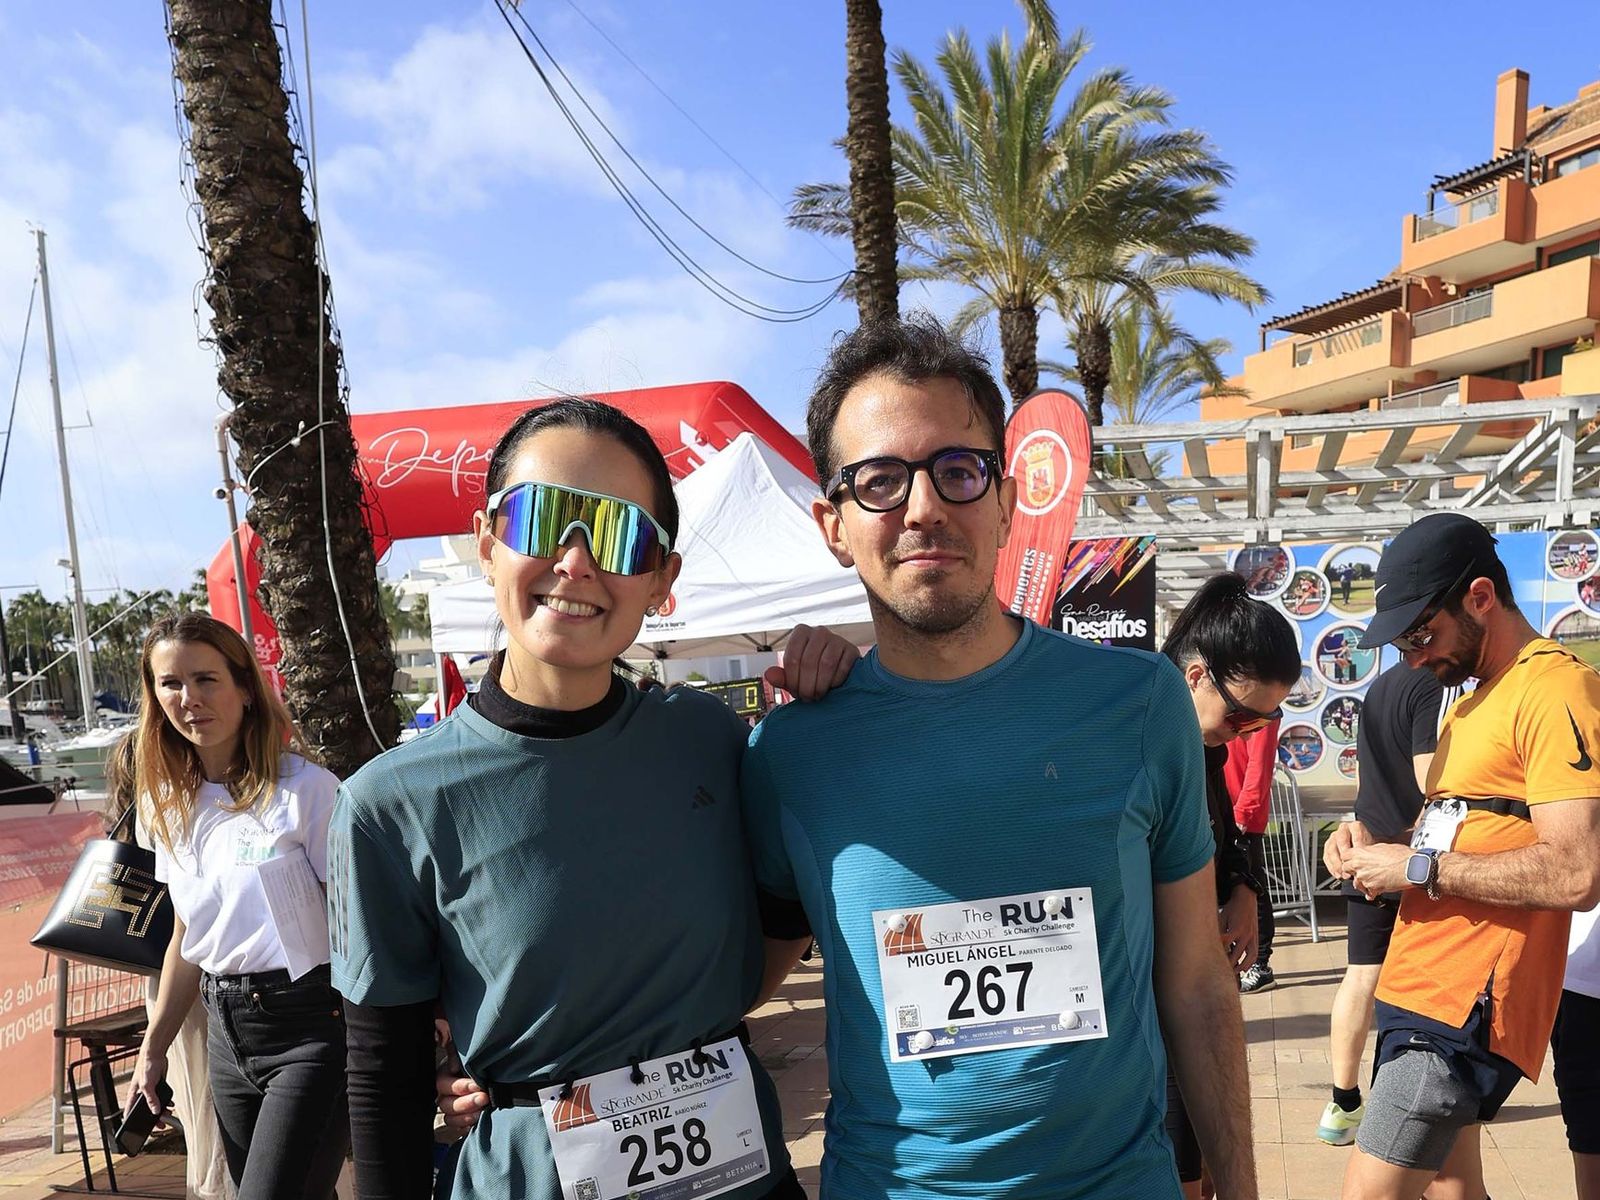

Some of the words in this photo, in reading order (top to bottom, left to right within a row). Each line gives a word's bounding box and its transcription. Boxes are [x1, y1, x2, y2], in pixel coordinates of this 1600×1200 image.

[369, 427, 494, 497] Depo
[1062, 613, 1147, 640] Desafíos
[962, 908, 993, 925] The
[1000, 896, 1074, 927] RUN
[1003, 928, 1012, 937] 5k
[1013, 925, 1040, 936] Charity
[1041, 921, 1075, 933] Challenge
[907, 950, 964, 968] MIGUEL
[967, 945, 1016, 961] ÁNGEL
[1018, 948, 1044, 956] PARENTE
[1045, 944, 1073, 954] DELGADO
[943, 961, 1034, 1021] 267
[1075, 993, 1085, 1004] M
[665, 1049, 730, 1086] RUN
[672, 1086, 681, 1095] 5k
[682, 1080, 703, 1093] Charity
[703, 1070, 734, 1085] Challenge
[612, 1105, 672, 1133] BEATRIZ
[619, 1117, 712, 1188] 258
[743, 1137, 750, 1147] L
[725, 1161, 758, 1179] BETANIA
